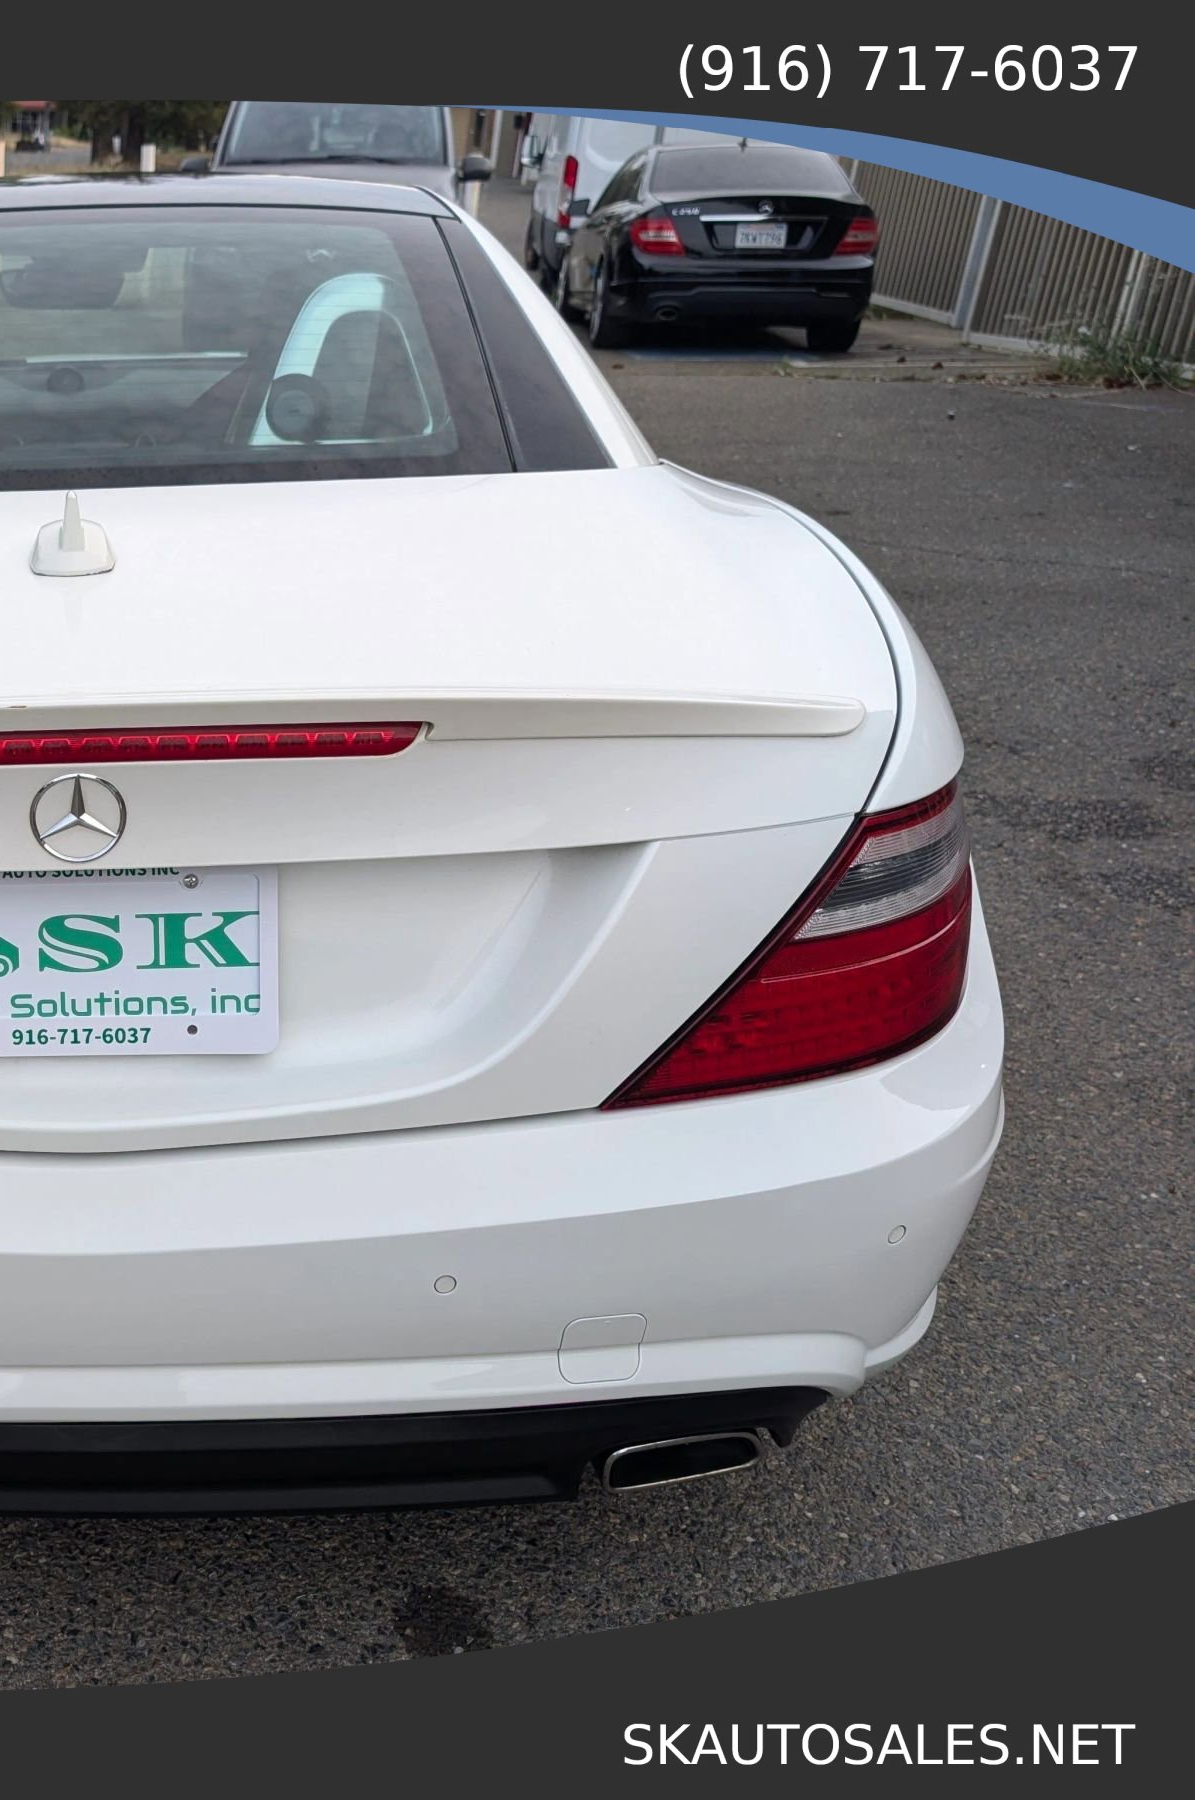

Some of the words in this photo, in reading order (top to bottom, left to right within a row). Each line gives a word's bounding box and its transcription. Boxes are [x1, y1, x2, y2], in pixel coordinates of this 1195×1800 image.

[37, 910, 261, 973] SK
[10, 990, 198, 1019] Solutions,
[210, 987, 261, 1016] inc
[11, 1027, 152, 1046] 916-717-6037
